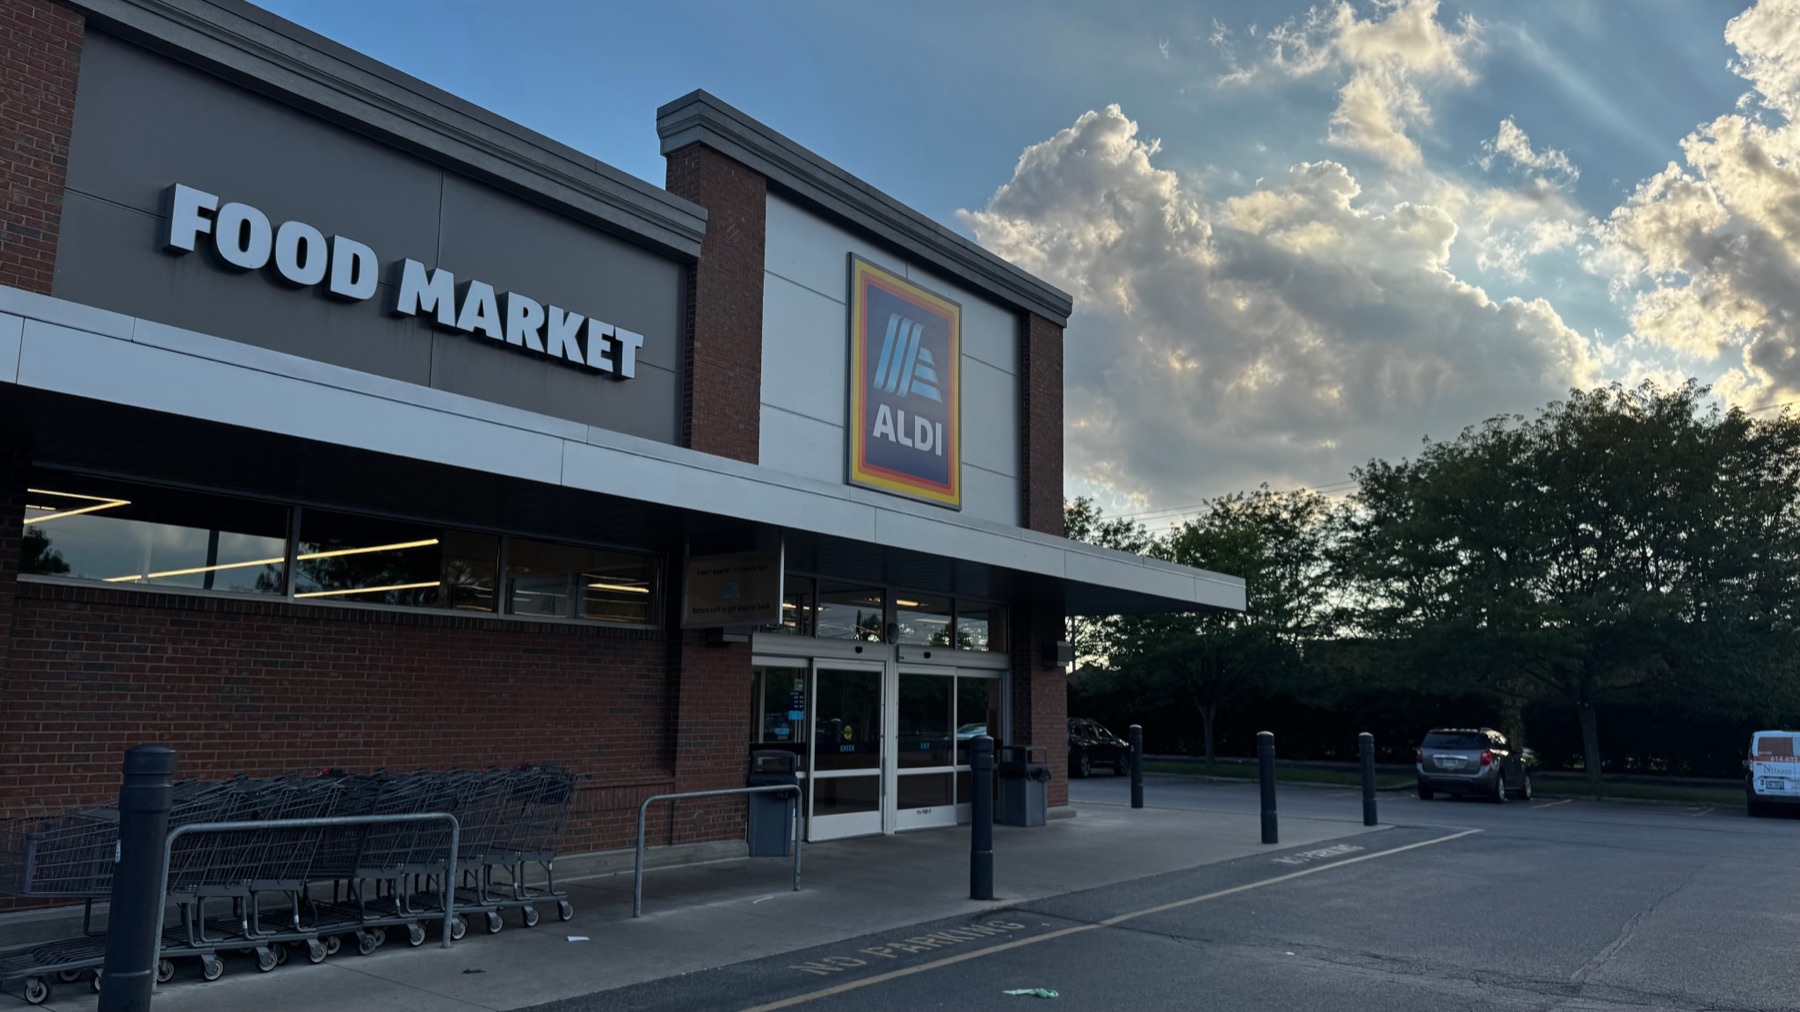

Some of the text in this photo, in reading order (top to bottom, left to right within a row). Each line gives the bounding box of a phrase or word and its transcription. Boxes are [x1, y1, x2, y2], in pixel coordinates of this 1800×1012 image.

[170, 182, 645, 380] FOOD MARKET
[872, 403, 943, 457] ALDI
[920, 742, 930, 750] EXIT
[790, 920, 1026, 976] NO PARKING
